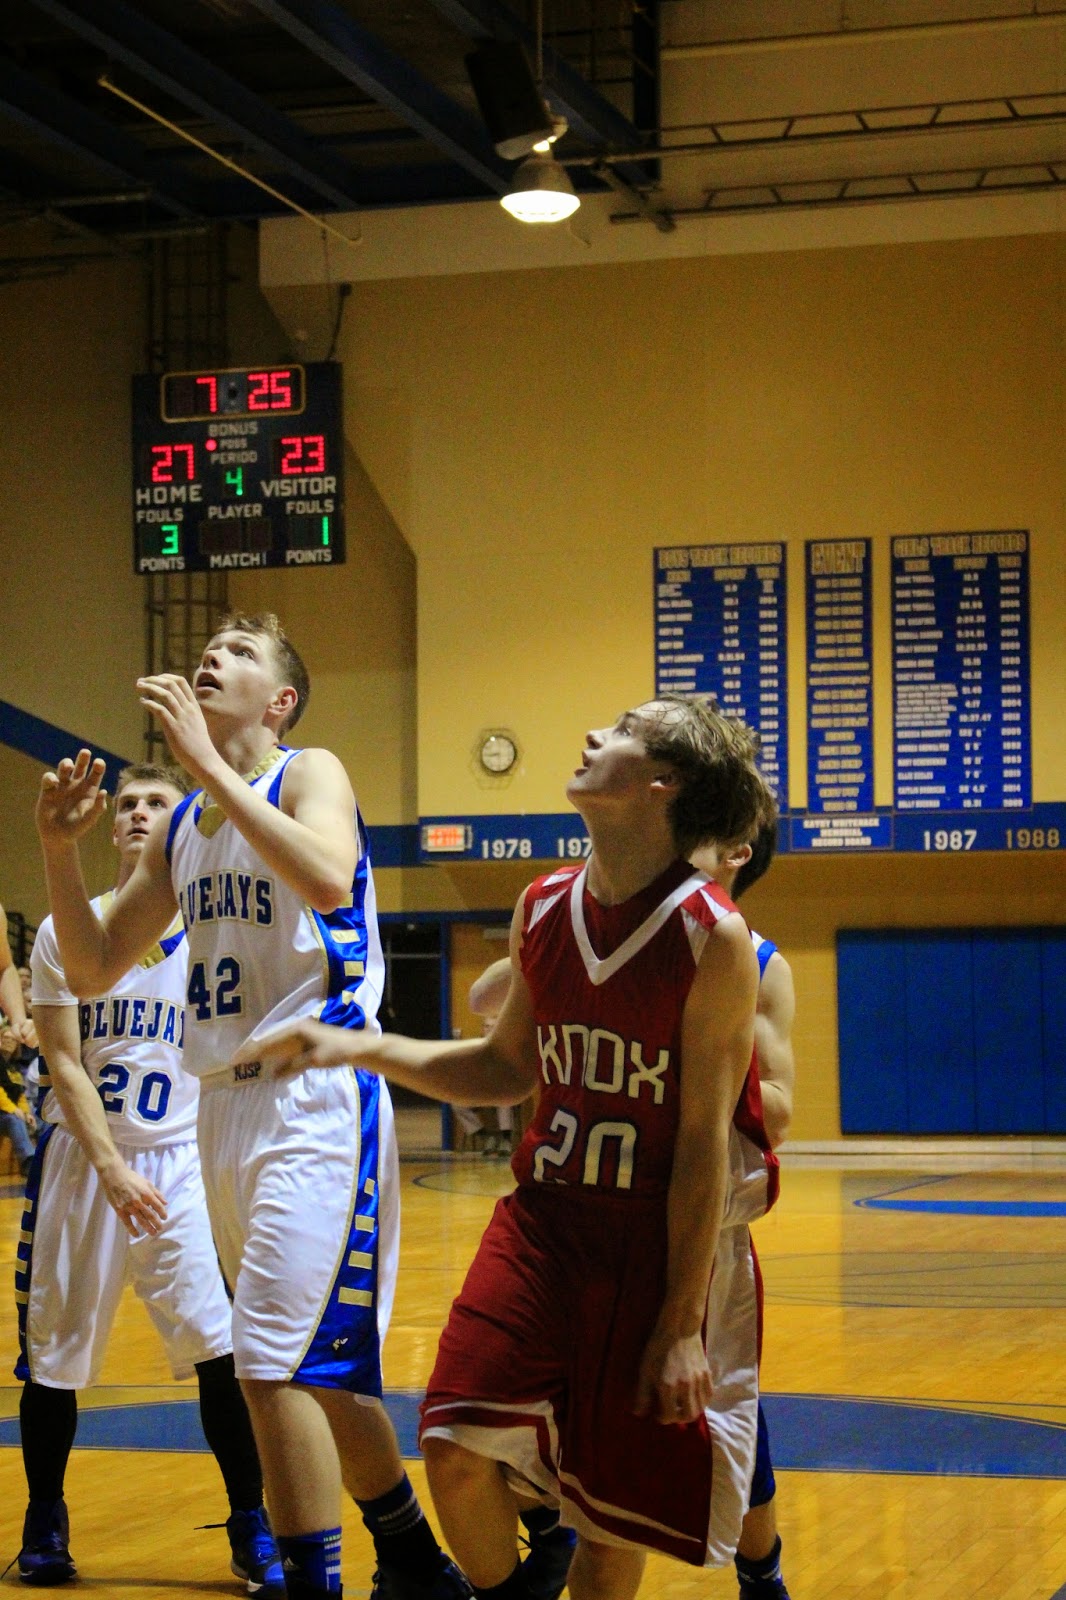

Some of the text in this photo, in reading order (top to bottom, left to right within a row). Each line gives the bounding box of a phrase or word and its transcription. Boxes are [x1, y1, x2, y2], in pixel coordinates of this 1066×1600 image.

[196, 371, 292, 413] 7 25
[209, 421, 258, 437] BONUS
[151, 443, 195, 483] 27
[211, 451, 258, 465] PERIOD
[281, 435, 325, 475] 23
[225, 466, 244, 496] 4
[260, 476, 337, 498] VISITOR
[136, 484, 202, 506] HOME
[136, 507, 184, 524] FOULS
[208, 503, 263, 519] PLAYER
[286, 499, 335, 515] FOULS
[161, 524, 179, 555] 3
[322, 516, 329, 546] 1
[139, 557, 185, 572] POINTS
[286, 549, 332, 564] POINTS
[481, 838, 533, 859] 1978
[557, 837, 593, 858] 197
[923, 829, 977, 851] 1987
[1005, 829, 1060, 849] 1988
[187, 955, 242, 1021] 42
[537, 1024, 670, 1105] KNOX
[97, 1062, 174, 1123] 20
